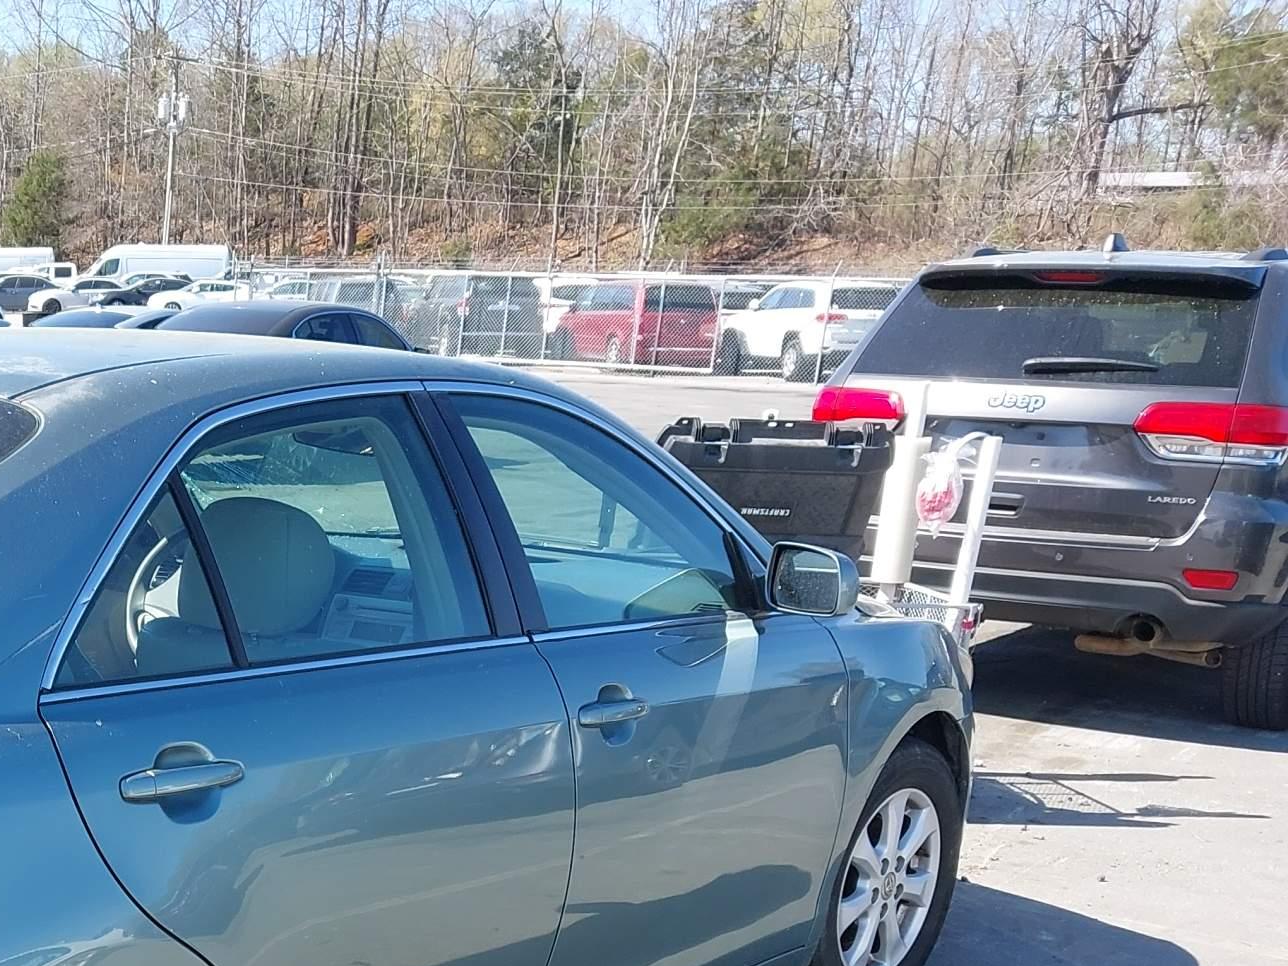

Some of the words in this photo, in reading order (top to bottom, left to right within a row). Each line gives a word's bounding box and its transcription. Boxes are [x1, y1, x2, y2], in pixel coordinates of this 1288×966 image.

[988, 392, 1046, 413] Jeep
[1148, 495, 1197, 505] LAREDO
[740, 507, 791, 516] CRAFTSMAN
